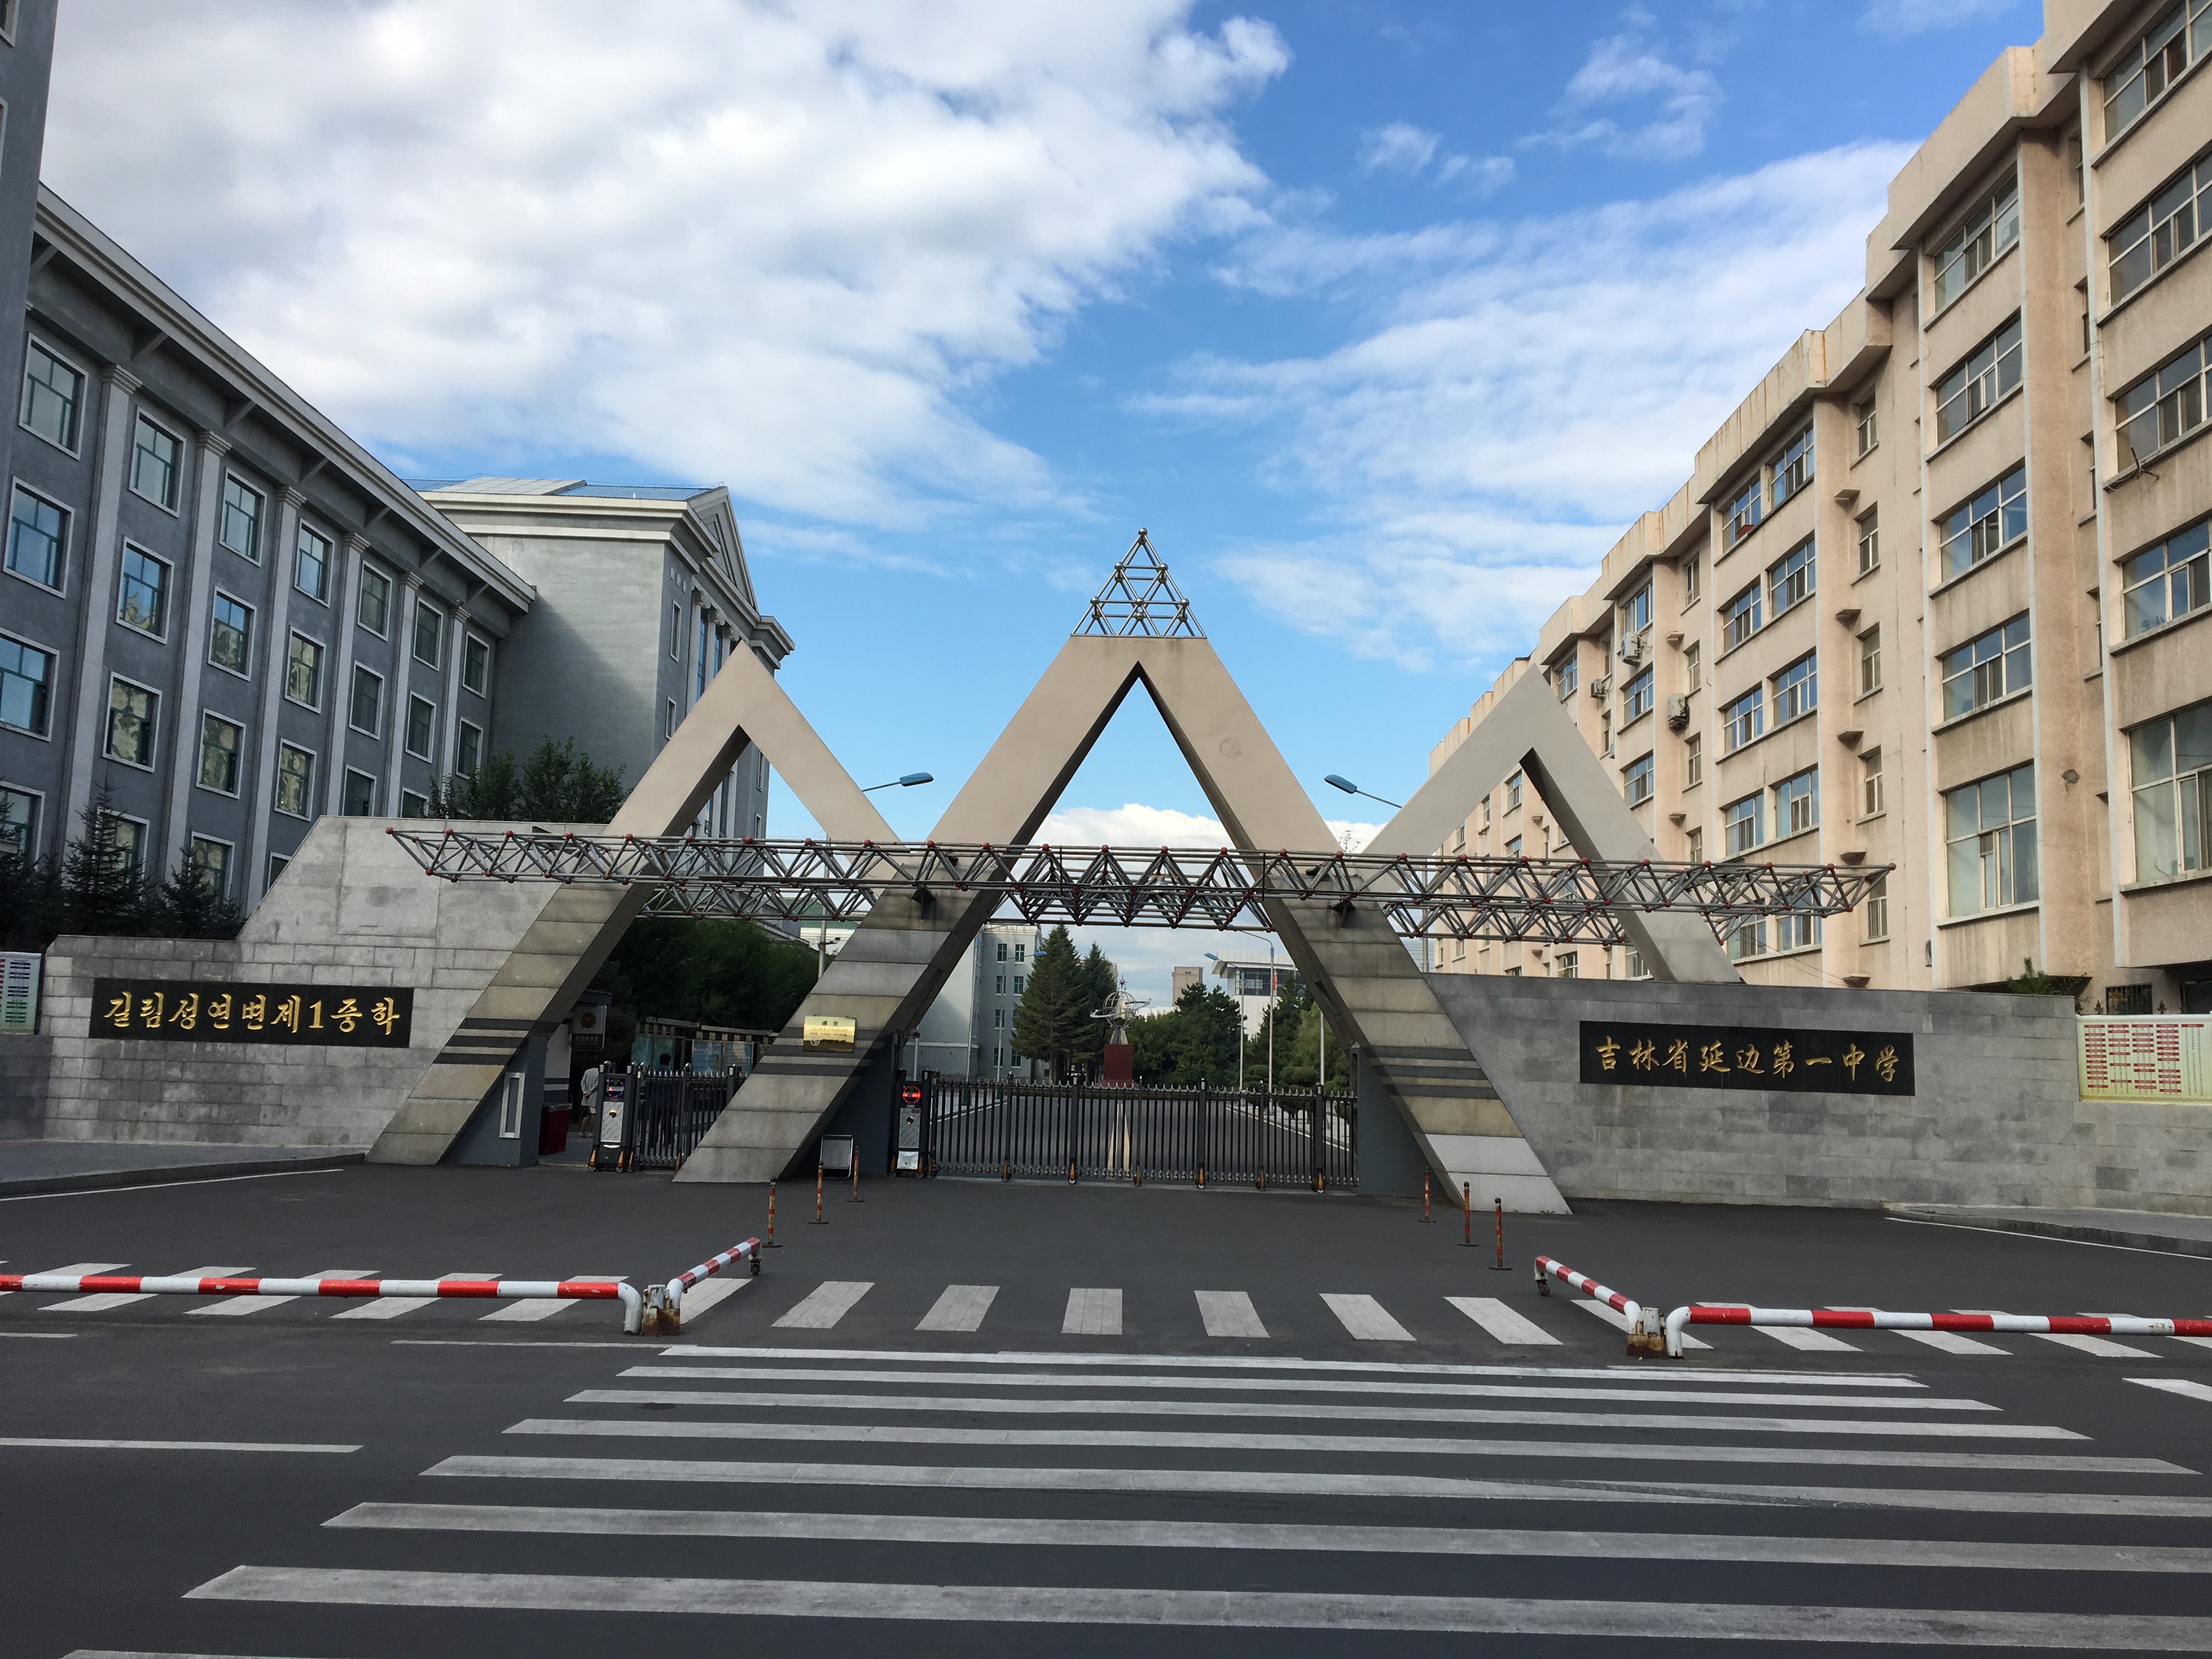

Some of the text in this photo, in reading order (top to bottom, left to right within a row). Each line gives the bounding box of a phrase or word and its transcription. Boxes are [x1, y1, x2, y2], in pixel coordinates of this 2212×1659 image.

[104, 991, 400, 1035] 길림성연변제1중학
[1596, 1036, 1899, 1082] 吉林省延边第一中学
